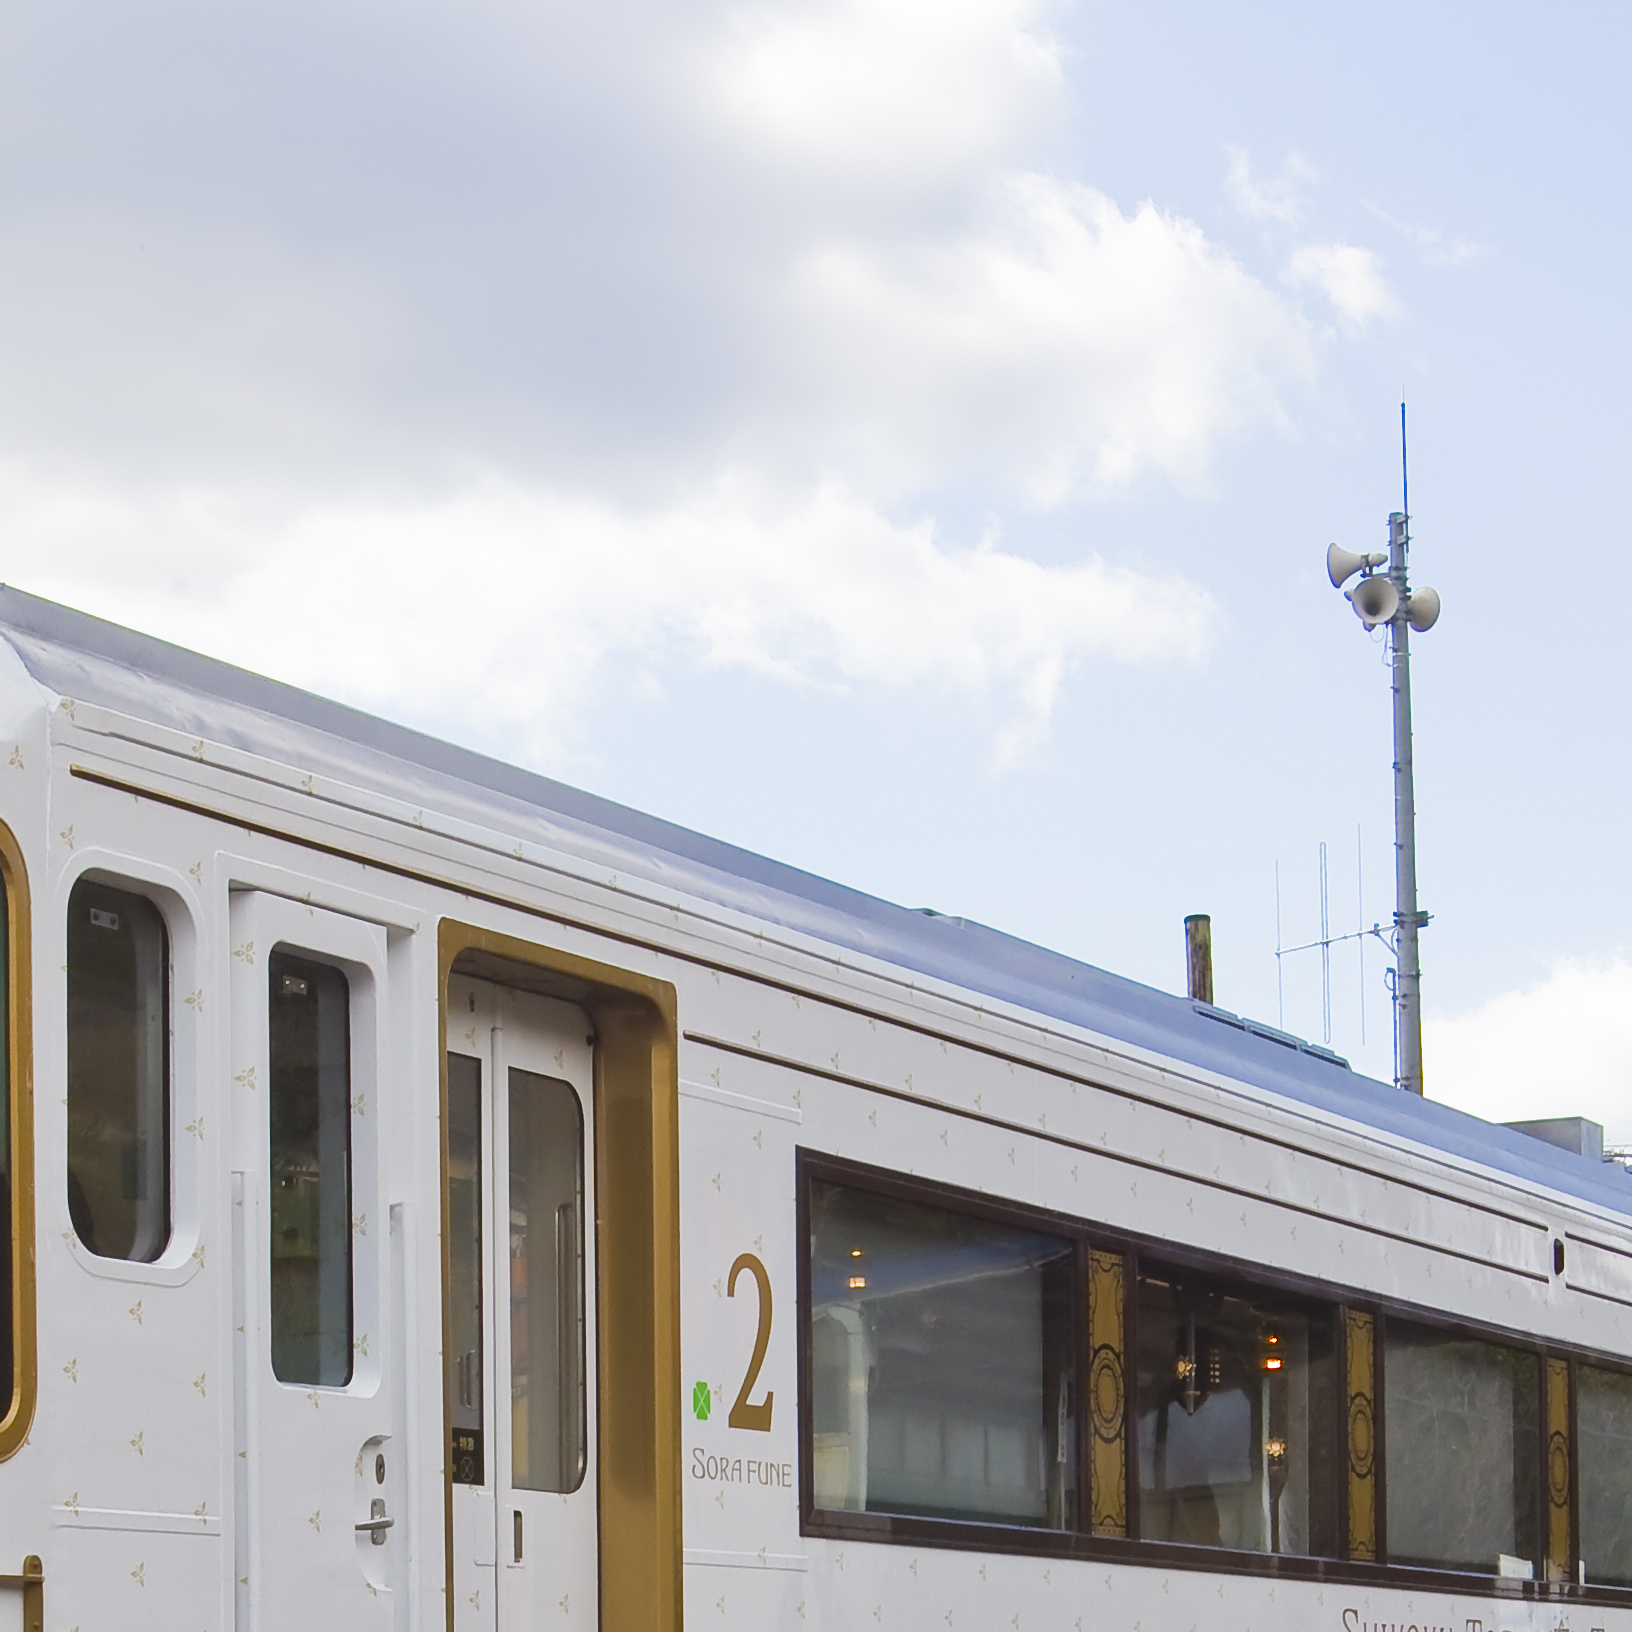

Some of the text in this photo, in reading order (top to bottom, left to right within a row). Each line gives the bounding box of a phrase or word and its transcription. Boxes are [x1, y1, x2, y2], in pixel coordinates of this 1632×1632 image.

[726, 1252, 774, 1433] 2
[691, 1447, 793, 1488] SORA FUNE
